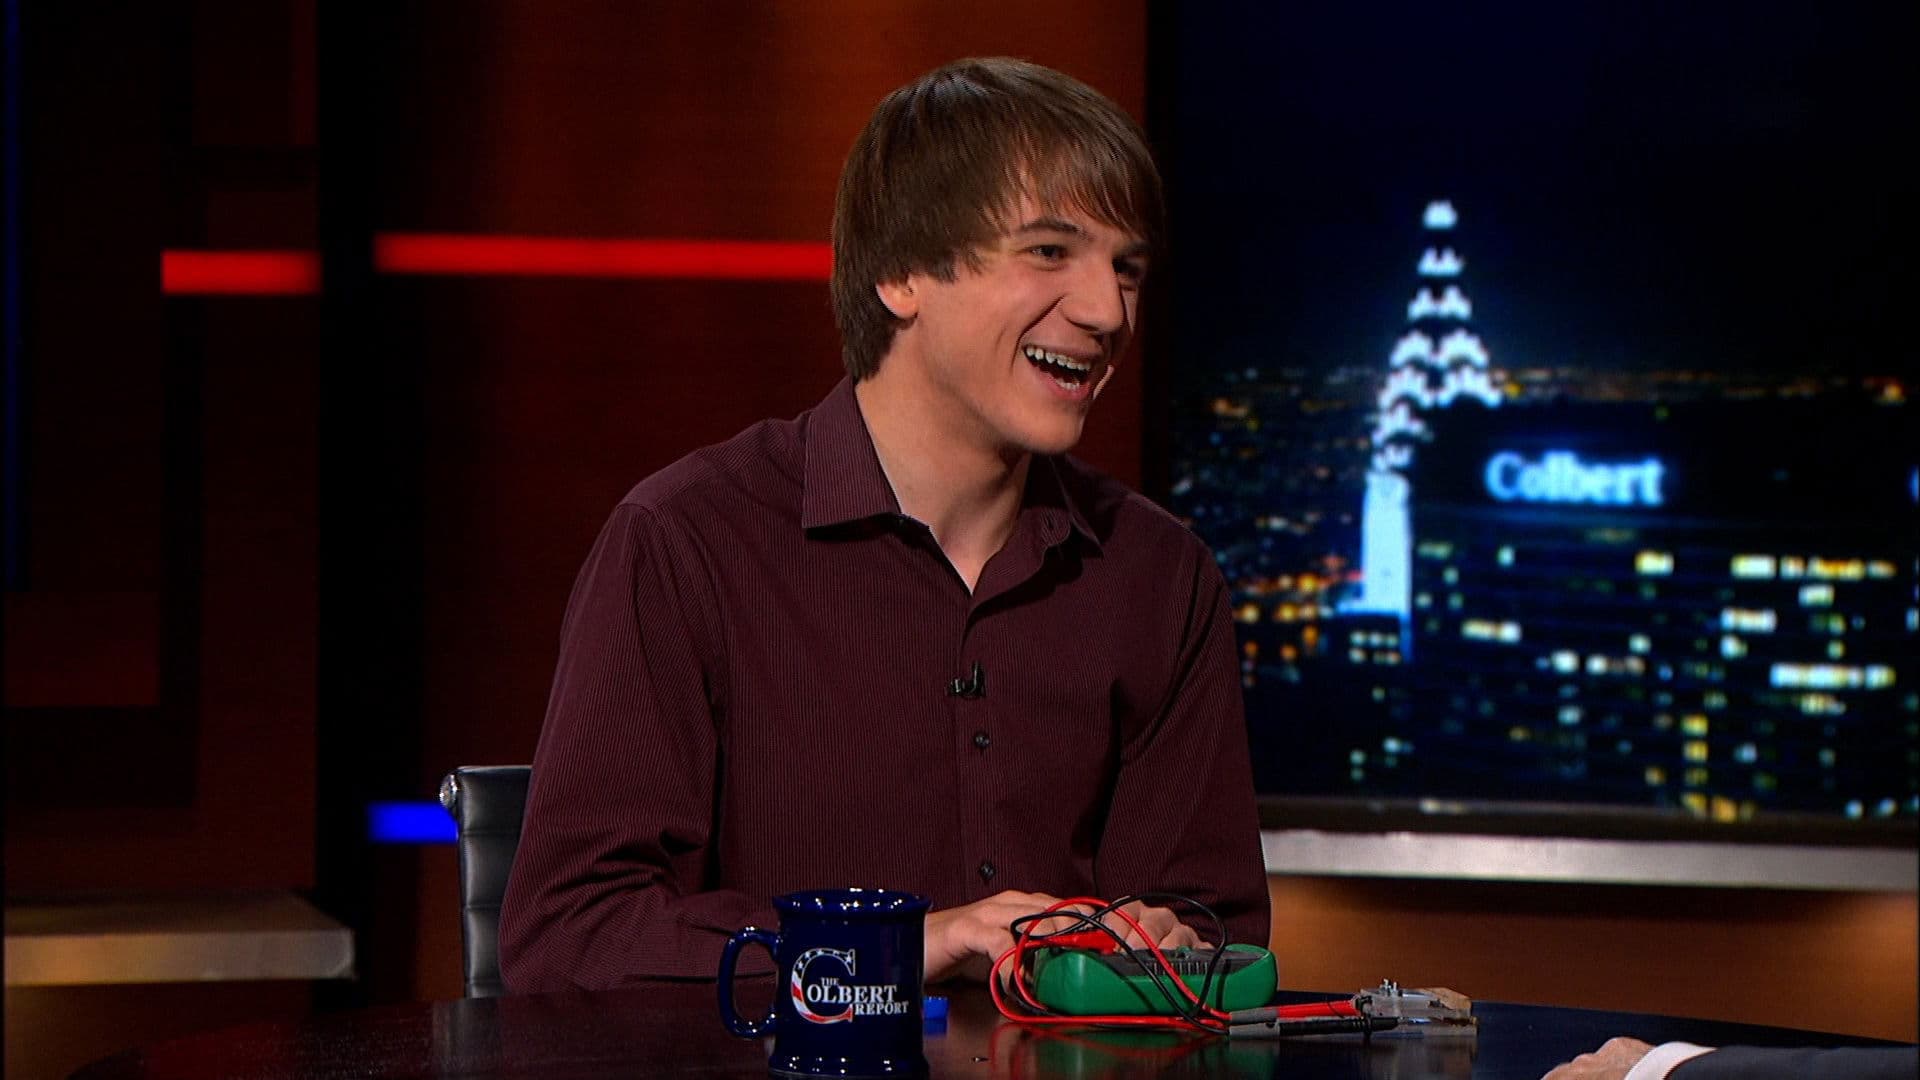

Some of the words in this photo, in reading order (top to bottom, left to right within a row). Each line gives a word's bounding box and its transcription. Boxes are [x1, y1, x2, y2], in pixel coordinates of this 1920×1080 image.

[1486, 450, 1664, 506] Colbert
[791, 947, 897, 1024] COLBERT
[821, 977, 840, 987] THE
[855, 1001, 909, 1016] REPORT
